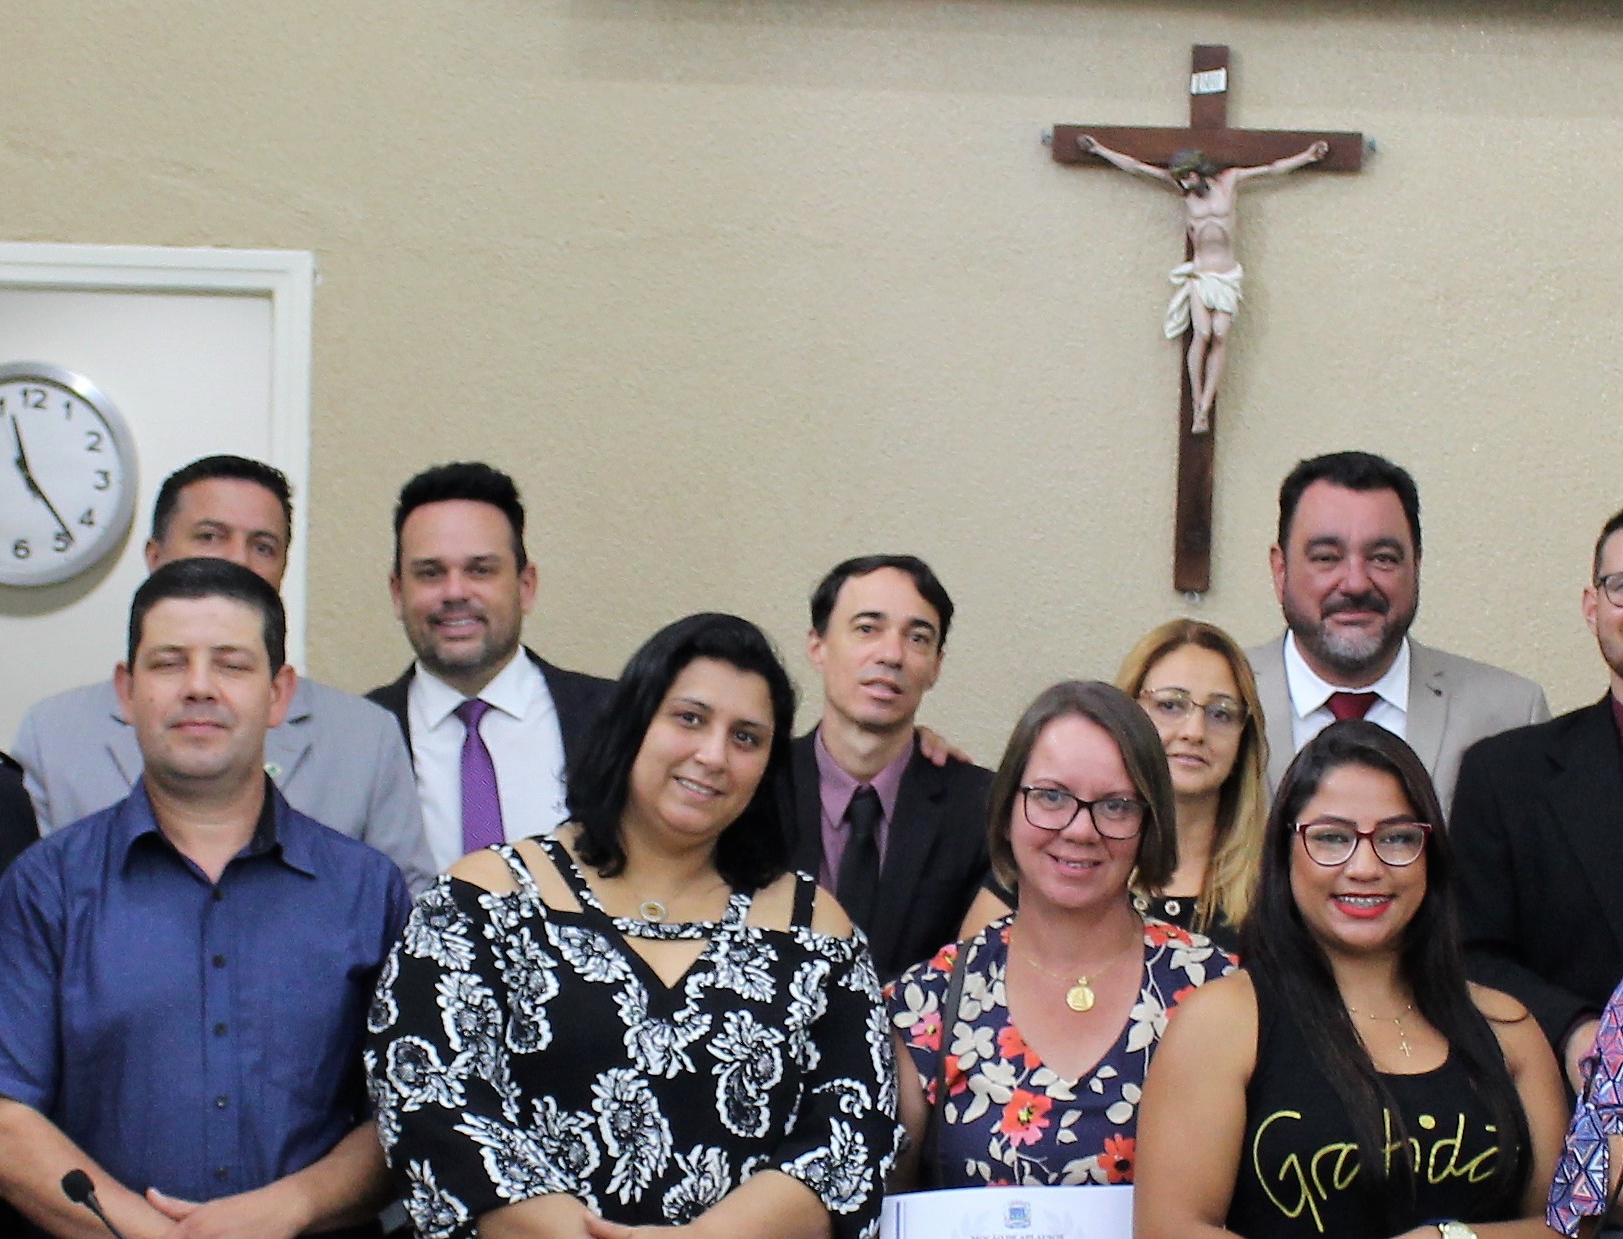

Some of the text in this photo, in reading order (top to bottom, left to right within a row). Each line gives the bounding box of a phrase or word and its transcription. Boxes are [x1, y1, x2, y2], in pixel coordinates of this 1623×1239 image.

[20, 388, 47, 410] 12
[62, 402, 72, 420] 1
[85, 431, 104, 452] 2
[93, 470, 110, 490] 3
[79, 508, 96, 527] 4
[13, 540, 31, 560] 6
[53, 531, 73, 552] 5
